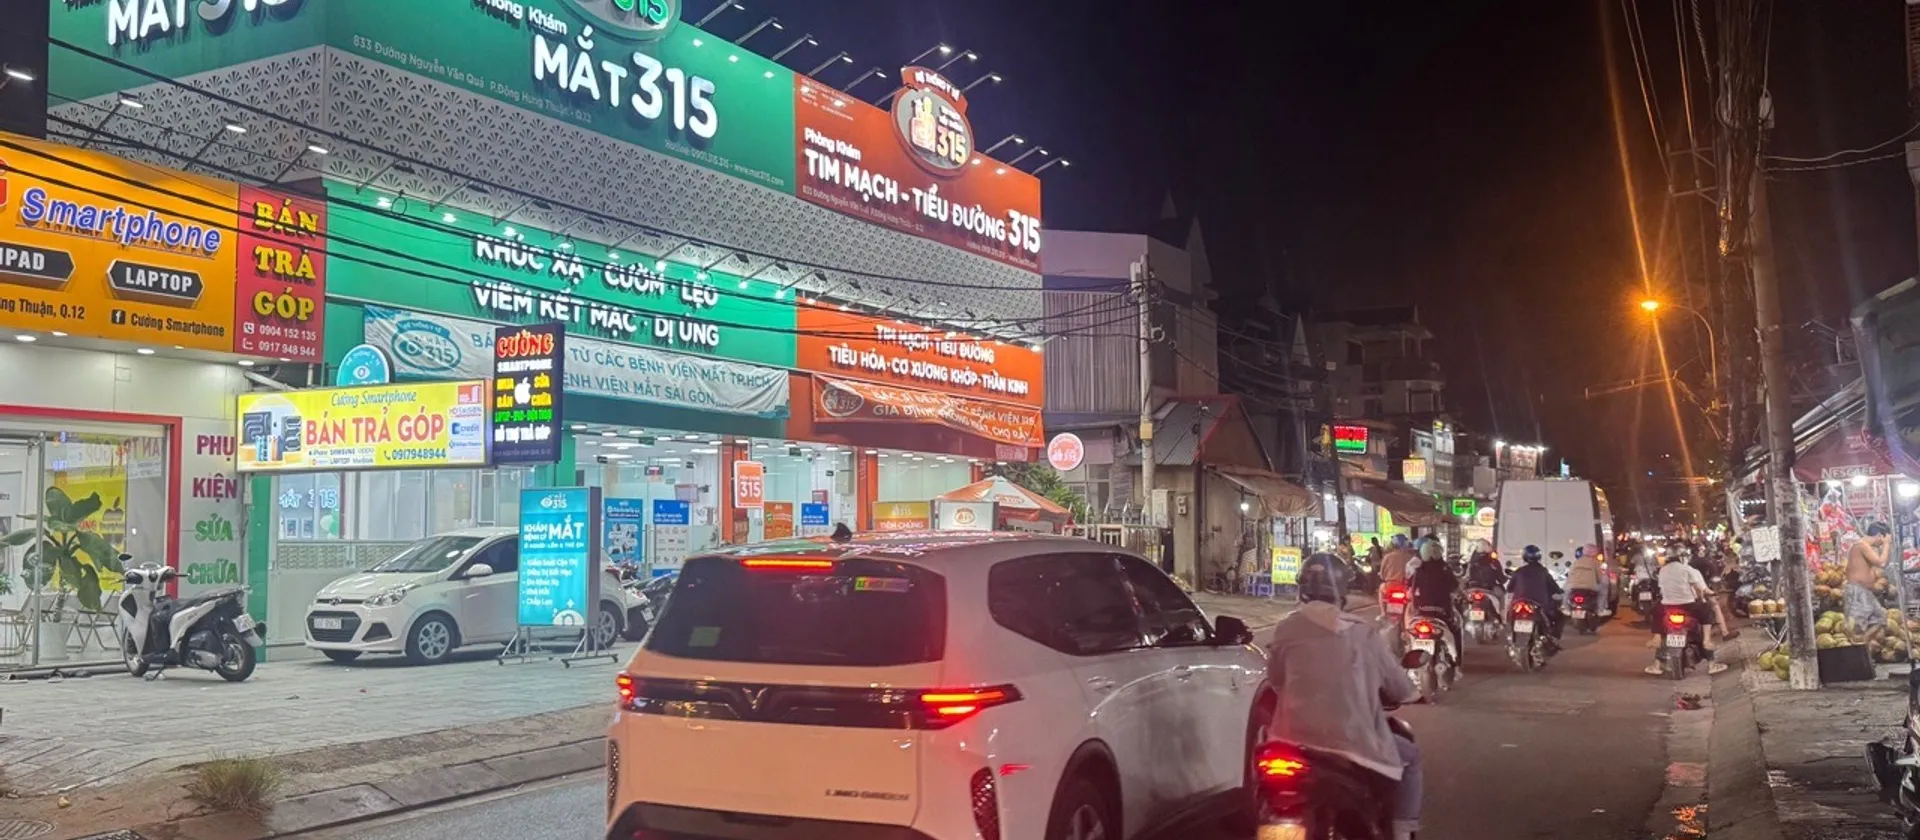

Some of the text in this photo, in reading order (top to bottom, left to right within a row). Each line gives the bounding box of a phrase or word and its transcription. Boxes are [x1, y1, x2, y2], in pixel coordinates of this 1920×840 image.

[529, 6, 567, 35] Khám
[353, 35, 372, 51] 833
[374, 42, 408, 65] Đường
[409, 52, 446, 75] Nguyễn
[447, 66, 465, 81] Văn
[466, 74, 486, 88] Quá
[534, 25, 628, 108] MẮT
[631, 51, 718, 139] 315
[804, 127, 861, 161] Phòng Khám
[937, 125, 967, 165] 315
[804, 149, 839, 185] TIM
[844, 158, 899, 204] MẠCH
[911, 183, 948, 222] TIỂU
[951, 203, 1005, 241] ĐƯỜNG
[1006, 208, 1041, 253] 315
[21, 187, 222, 253] Smartphone
[254, 197, 320, 236] BÁN
[254, 243, 317, 279] TRẢ
[476, 233, 719, 309] KHÚC XẠ CƯỜM LẸO
[125, 267, 193, 293] LAPTOP
[60, 306, 86, 321] Q.12
[253, 286, 316, 321] GÓP
[472, 279, 533, 315] VIÊM
[539, 286, 586, 323] KẾT
[590, 302, 638, 337] MẠC
[655, 315, 675, 344] DỊ
[130, 312, 226, 338] Cường Smartphone
[259, 324, 317, 341] 0904 152 135
[258, 340, 281, 352] 0917
[300, 346, 316, 357] 944
[425, 344, 456, 364] 315
[496, 329, 555, 358] CƯỜNG
[959, 340, 996, 364] ĐƯỜNG
[570, 347, 591, 363] TỪ
[595, 350, 625, 369] CÁC
[629, 354, 665, 375] BỆNH
[668, 357, 698, 379] VIỆN
[701, 361, 728, 383] MẮT
[861, 348, 888, 372] HÓA
[890, 358, 909, 374] CƠ
[911, 361, 949, 382] XƯƠNG
[950, 365, 979, 387] KHỚP
[980, 368, 1007, 390] THẦN
[1008, 379, 1029, 394] KINH
[360, 390, 417, 406] Smartphone
[595, 374, 685, 401] VIỆN MẮT SÀI
[872, 403, 900, 417] GIA
[305, 405, 445, 446] BÁN TRẢ GÓP
[196, 434, 236, 462] PHỤ
[392, 447, 447, 461] 0917948944
[193, 473, 238, 503] KIỆN
[740, 481, 761, 498] 315
[195, 512, 234, 542] SỬA
[548, 513, 584, 540] MẮT
[187, 557, 239, 586] CHỮA
